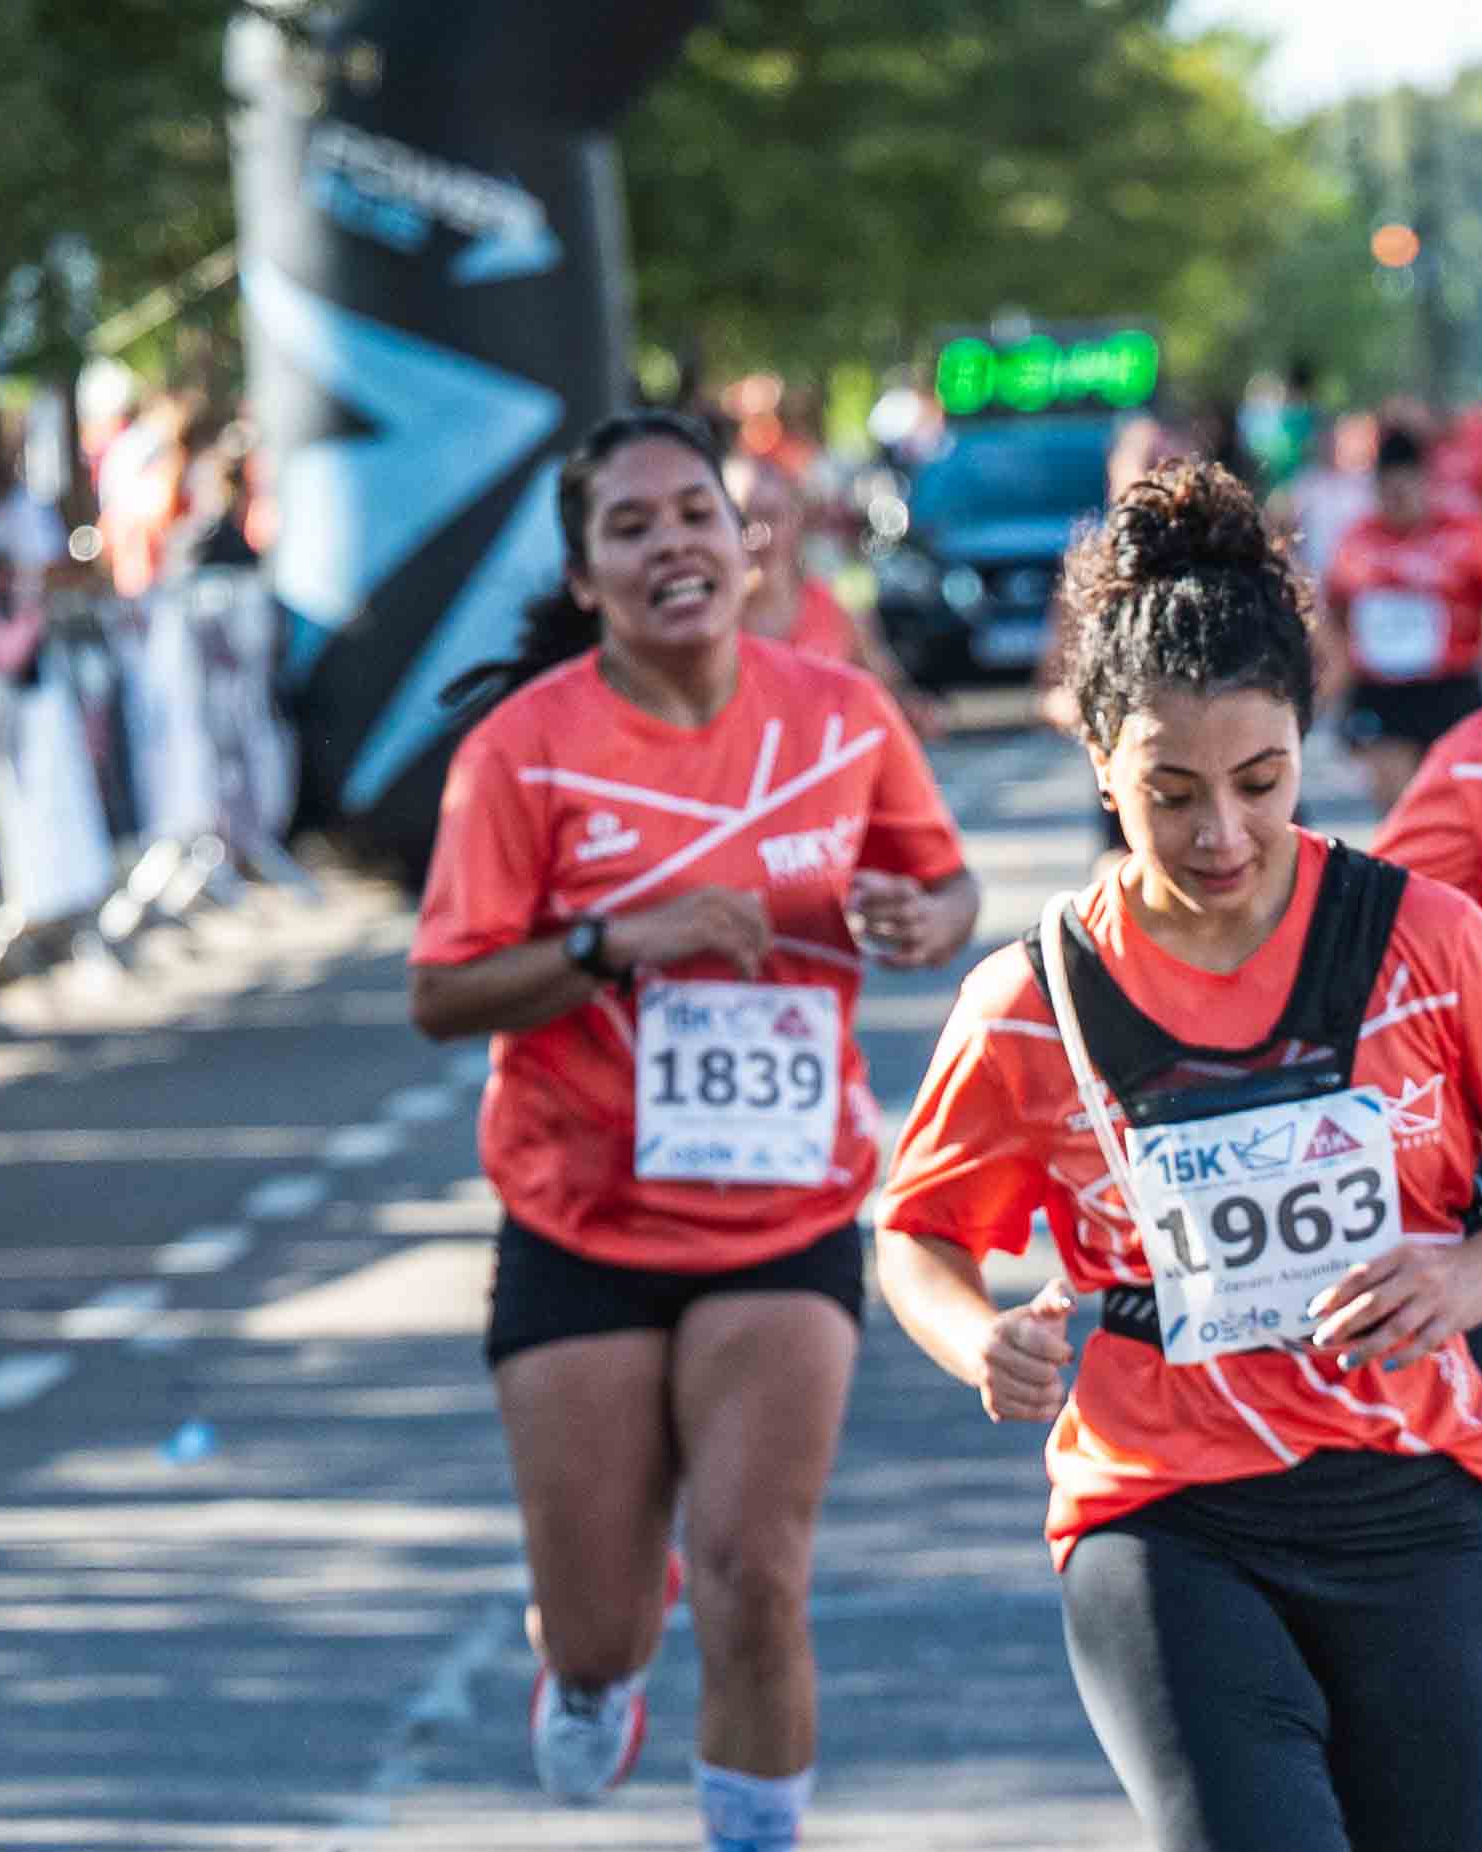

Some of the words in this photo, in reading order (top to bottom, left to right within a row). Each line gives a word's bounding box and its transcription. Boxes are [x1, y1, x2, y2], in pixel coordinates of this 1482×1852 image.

[650, 1047, 824, 1111] 1839
[1155, 1144, 1226, 1185] 15K
[1155, 1165, 1387, 1275] 1963
